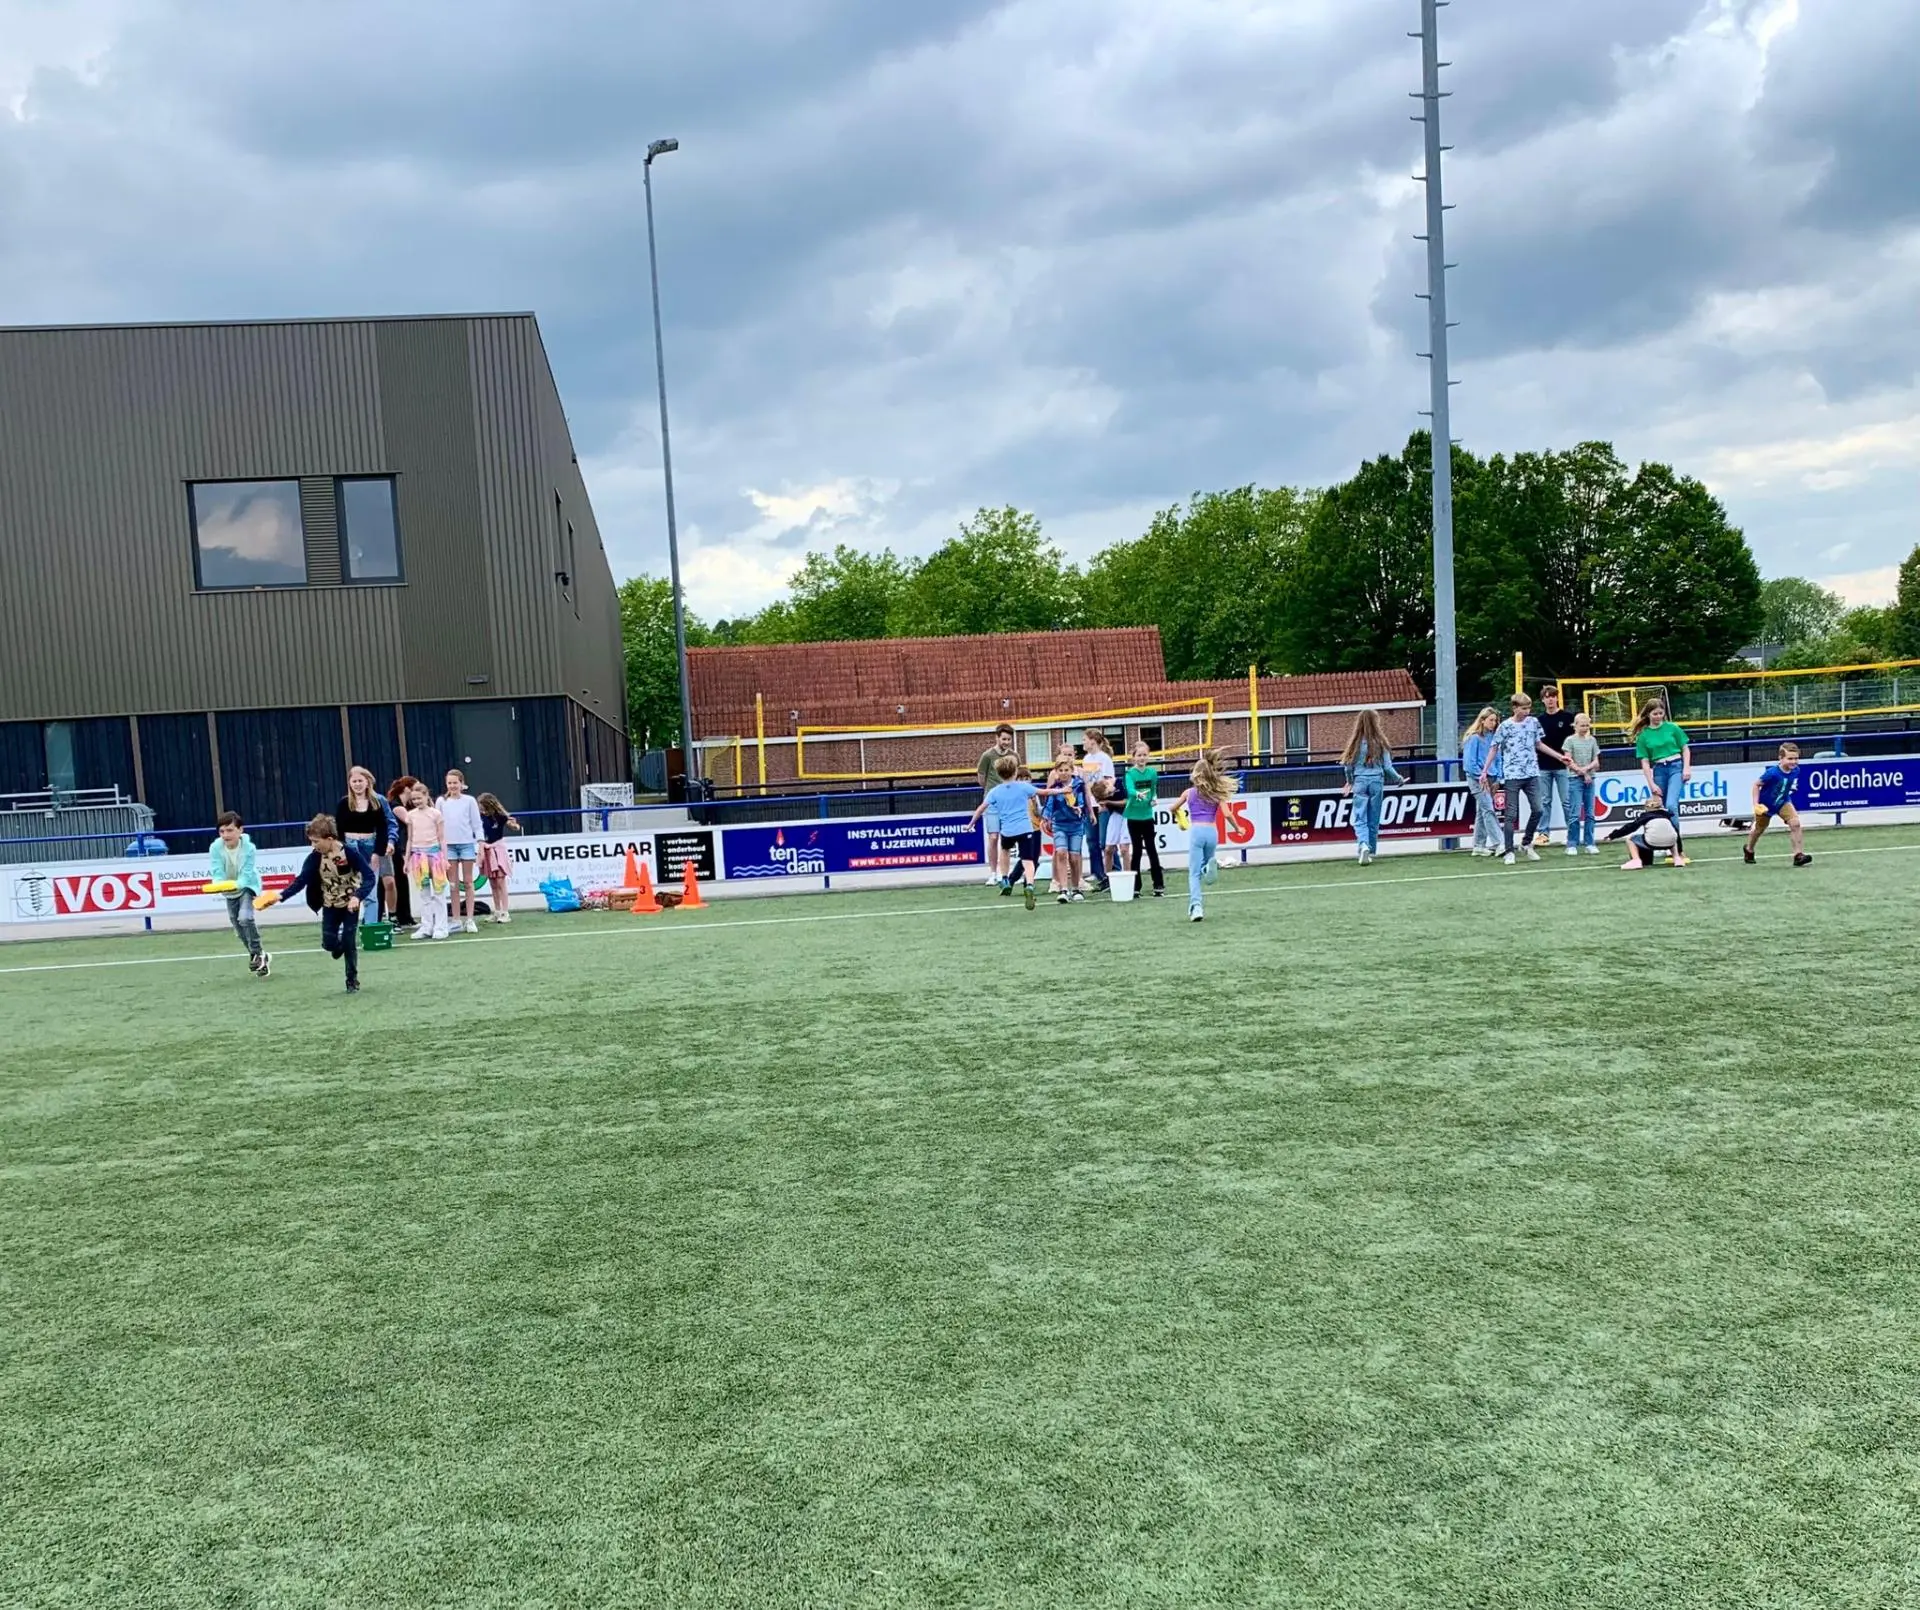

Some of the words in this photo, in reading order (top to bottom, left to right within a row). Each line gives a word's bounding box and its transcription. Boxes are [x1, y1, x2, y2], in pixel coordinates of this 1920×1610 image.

[1810, 768, 1903, 790] Oldenhave
[1680, 802, 1723, 815] Reclame
[667, 845, 706, 853] onderhoud
[870, 841, 879, 850] &
[882, 837, 955, 850] IJZERWAREN
[537, 841, 652, 861] VREGELAAR
[769, 845, 797, 861] ten
[786, 859, 825, 874] dam
[55, 873, 152, 913] VOS
[640, 885, 646, 895] 3
[684, 884, 690, 896] 2
